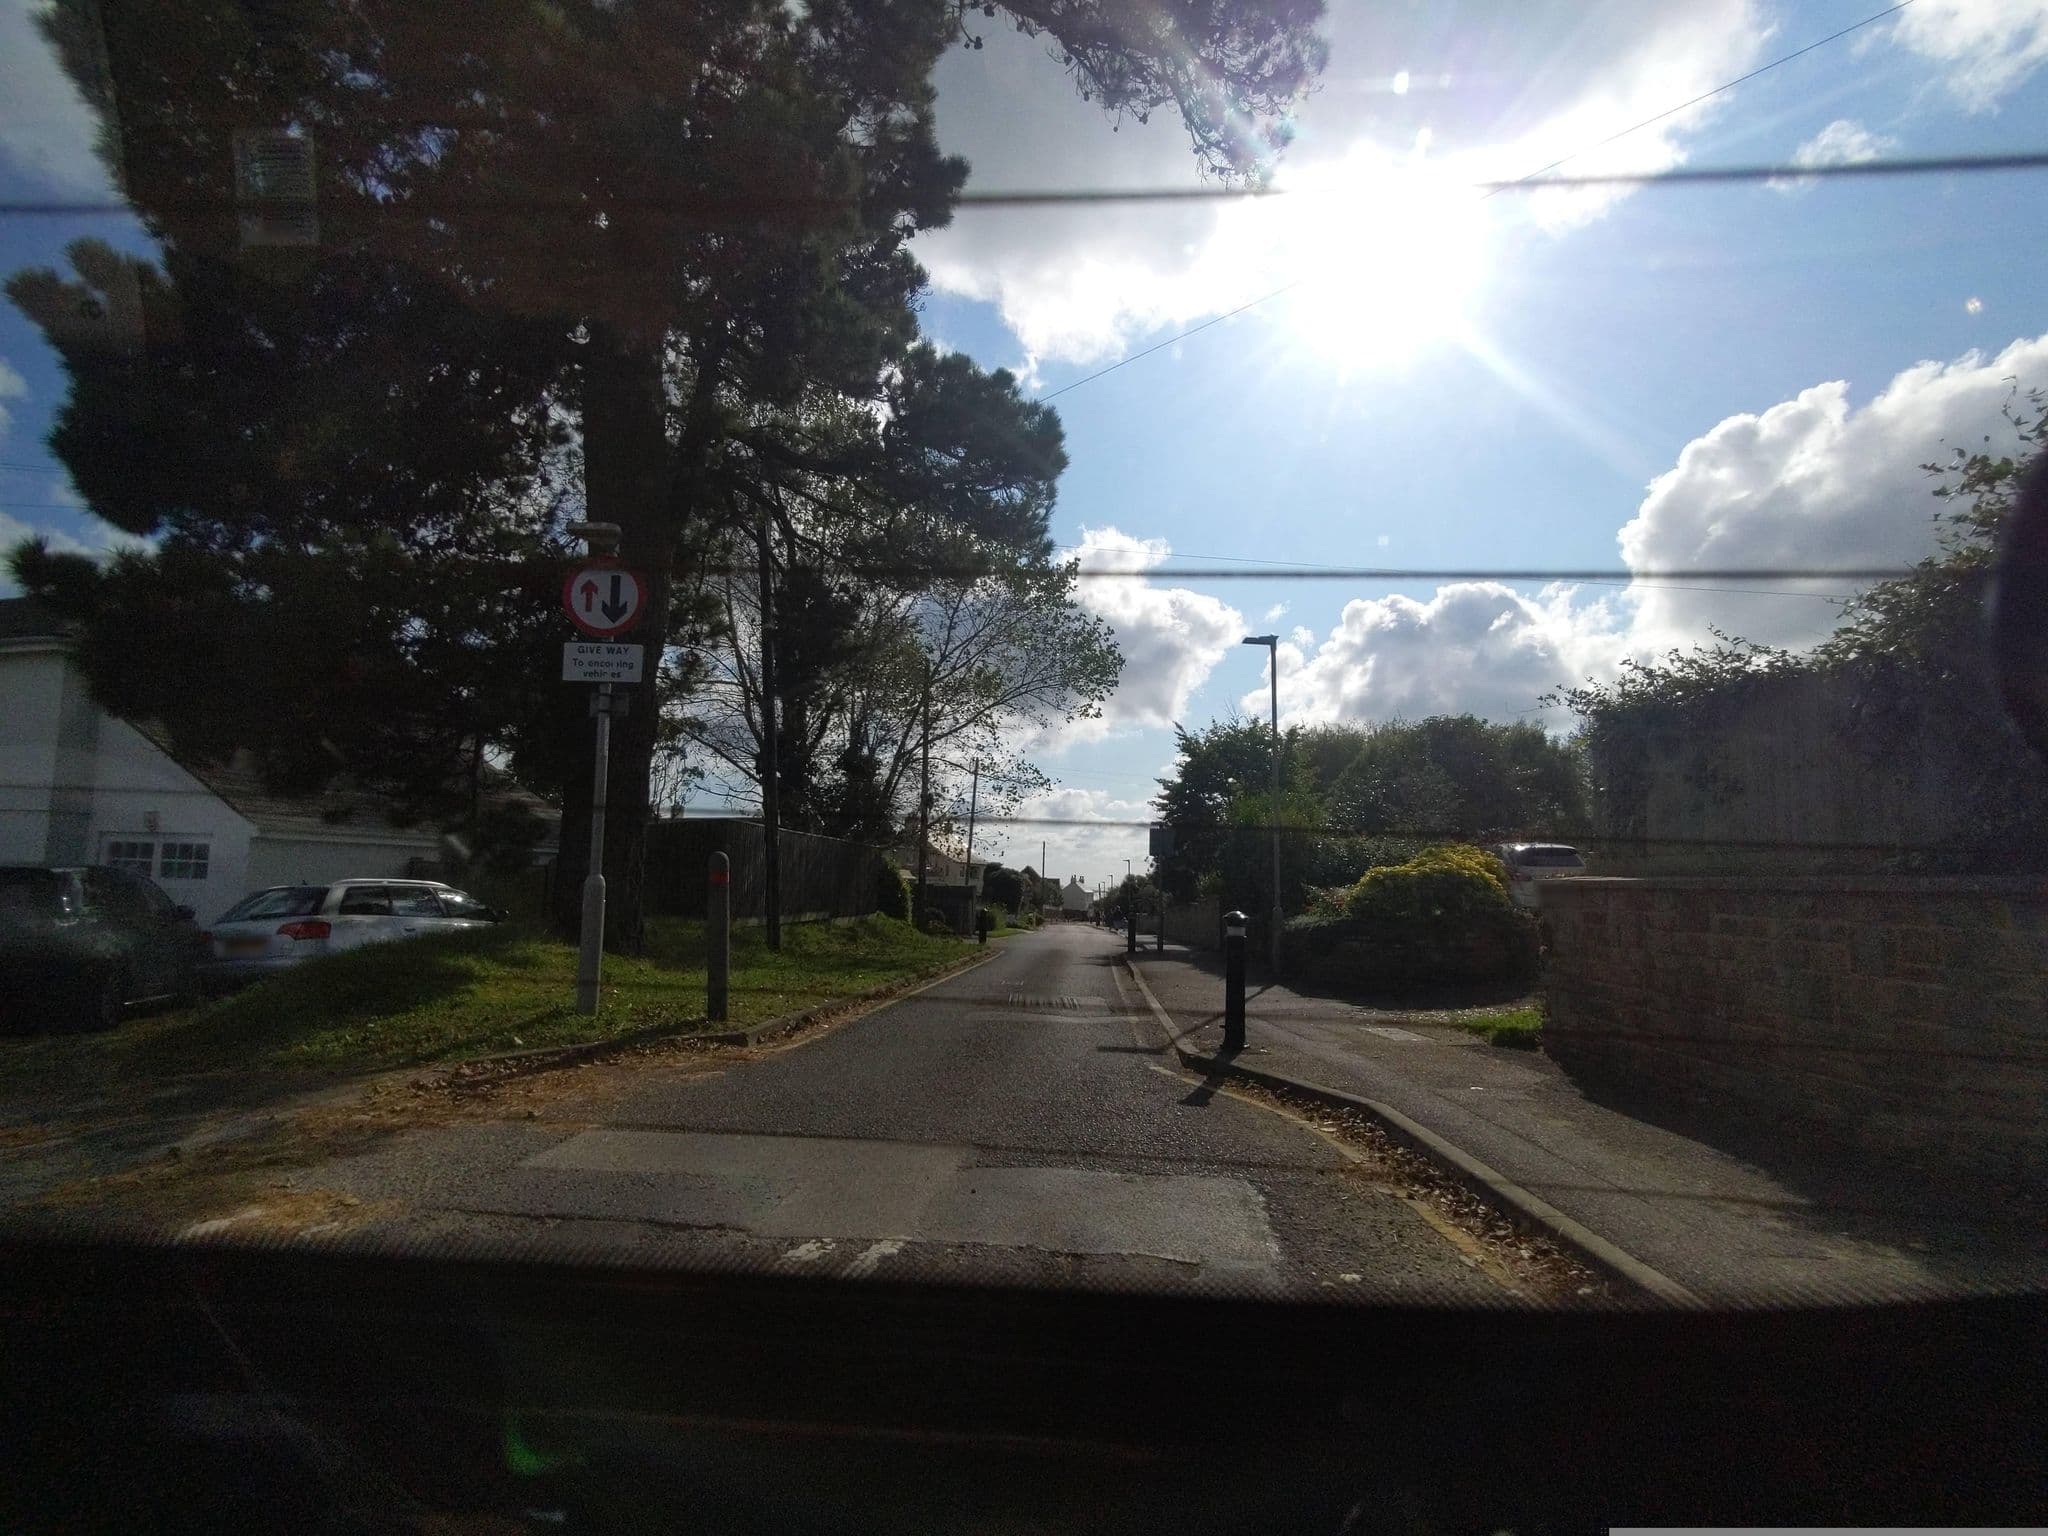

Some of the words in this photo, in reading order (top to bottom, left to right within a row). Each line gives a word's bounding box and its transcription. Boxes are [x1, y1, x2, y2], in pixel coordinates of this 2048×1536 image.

[577, 645, 602, 655] GIVE
[606, 645, 630, 655] WAY
[572, 658, 584, 666] To
[583, 669, 621, 678] vehices
